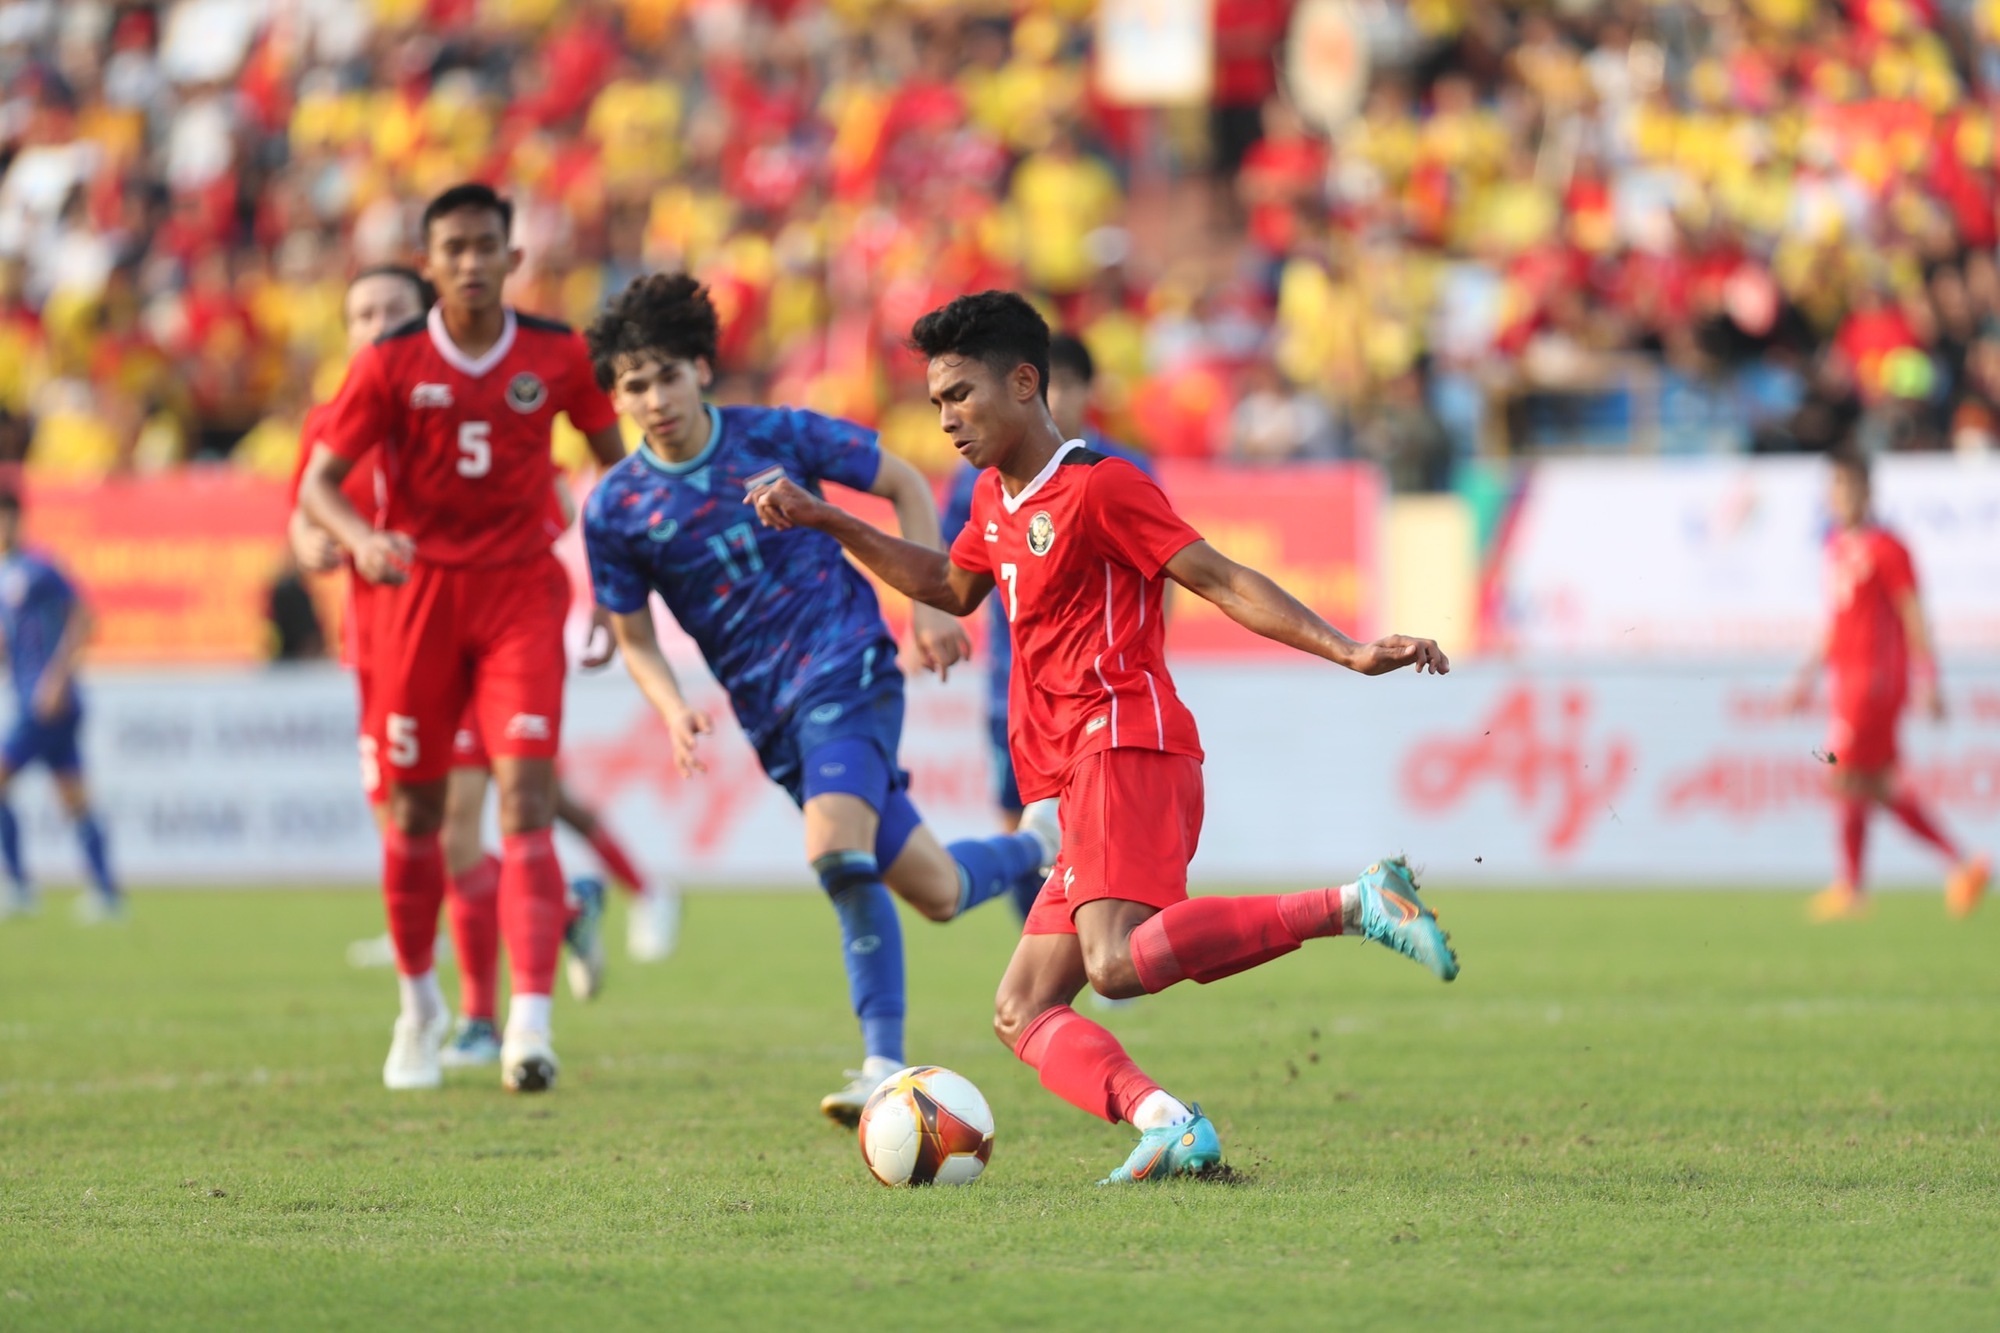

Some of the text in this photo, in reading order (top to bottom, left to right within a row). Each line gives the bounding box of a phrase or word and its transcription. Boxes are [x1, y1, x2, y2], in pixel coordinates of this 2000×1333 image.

[457, 420, 492, 478] 5
[706, 522, 764, 582] 17
[1001, 563, 1018, 622] 7
[386, 713, 419, 767] 5
